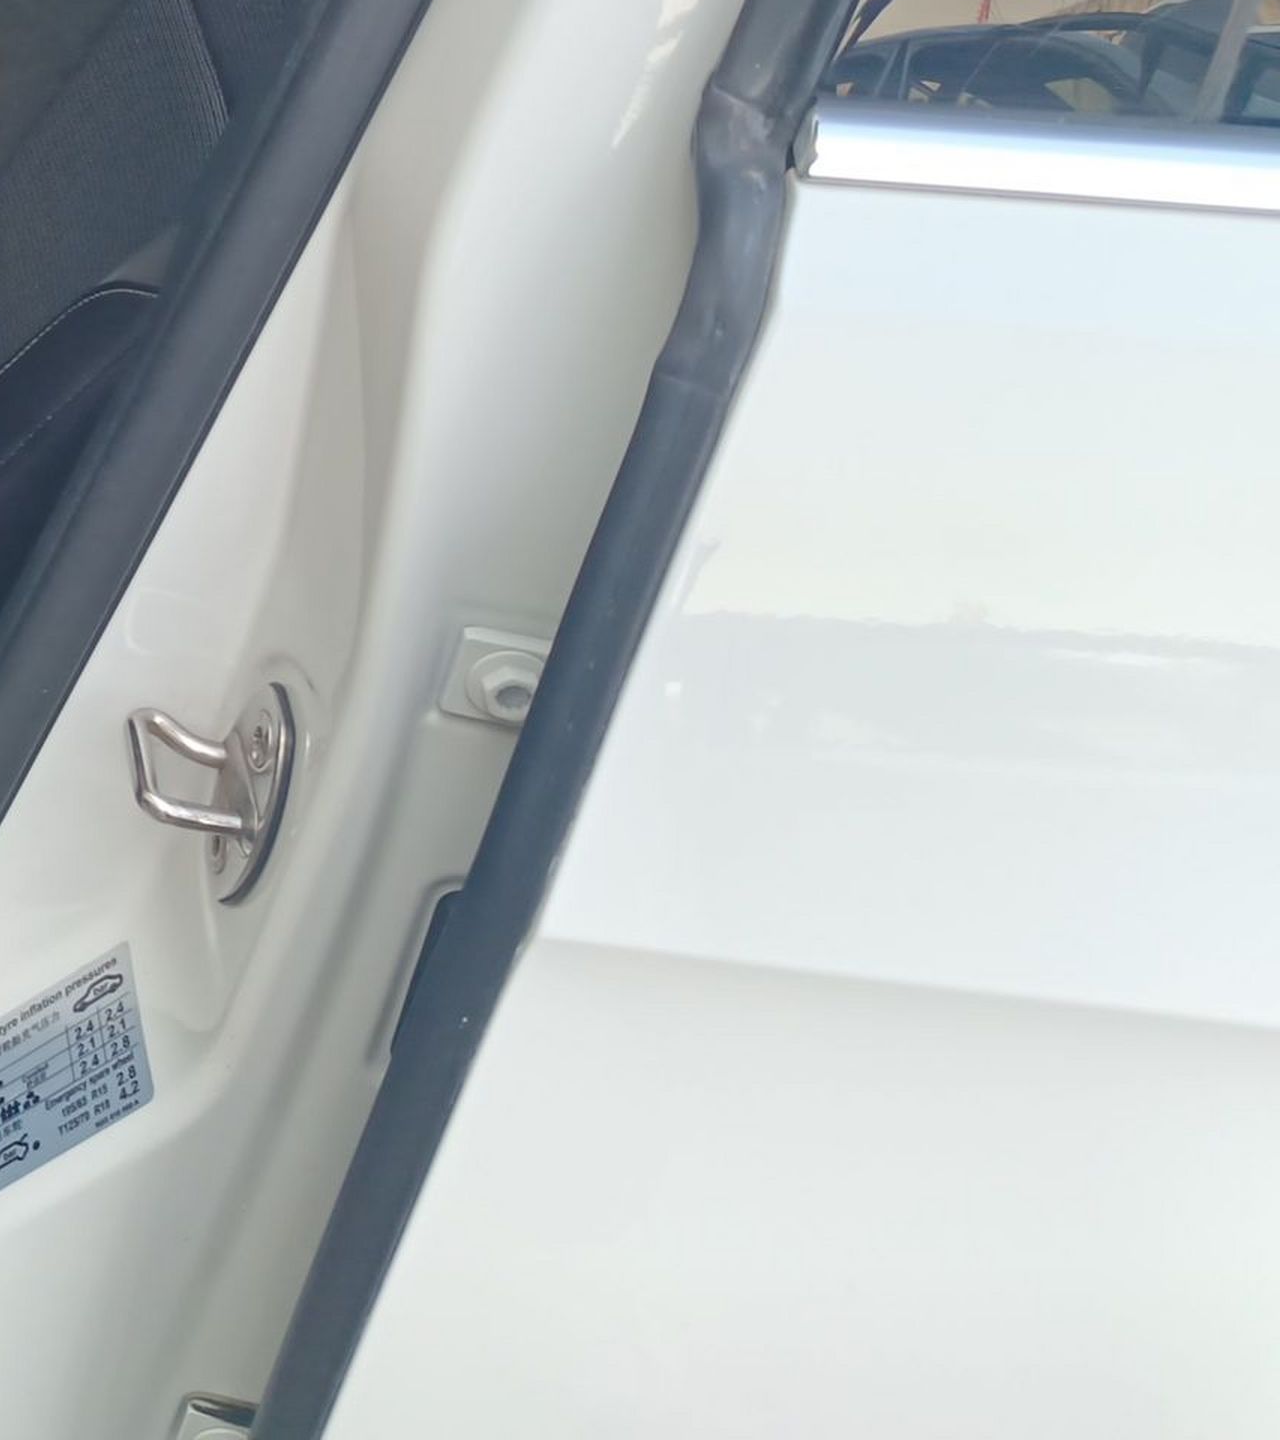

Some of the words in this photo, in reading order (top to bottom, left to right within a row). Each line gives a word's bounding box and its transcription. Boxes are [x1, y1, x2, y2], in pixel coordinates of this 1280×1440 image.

[20, 990, 63, 1021] inflation
[64, 957, 117, 996] pressures
[74, 1020, 94, 1040] 2.4
[105, 1001, 124, 1021] 2.4
[78, 1037, 96, 1057] 2.1
[107, 1018, 126, 1038] 2.1
[80, 1054, 100, 1074] 2.4
[110, 1035, 130, 1057] 2.8
[116, 1064, 137, 1087] 2.8
[119, 1080, 140, 1100] 4.2
